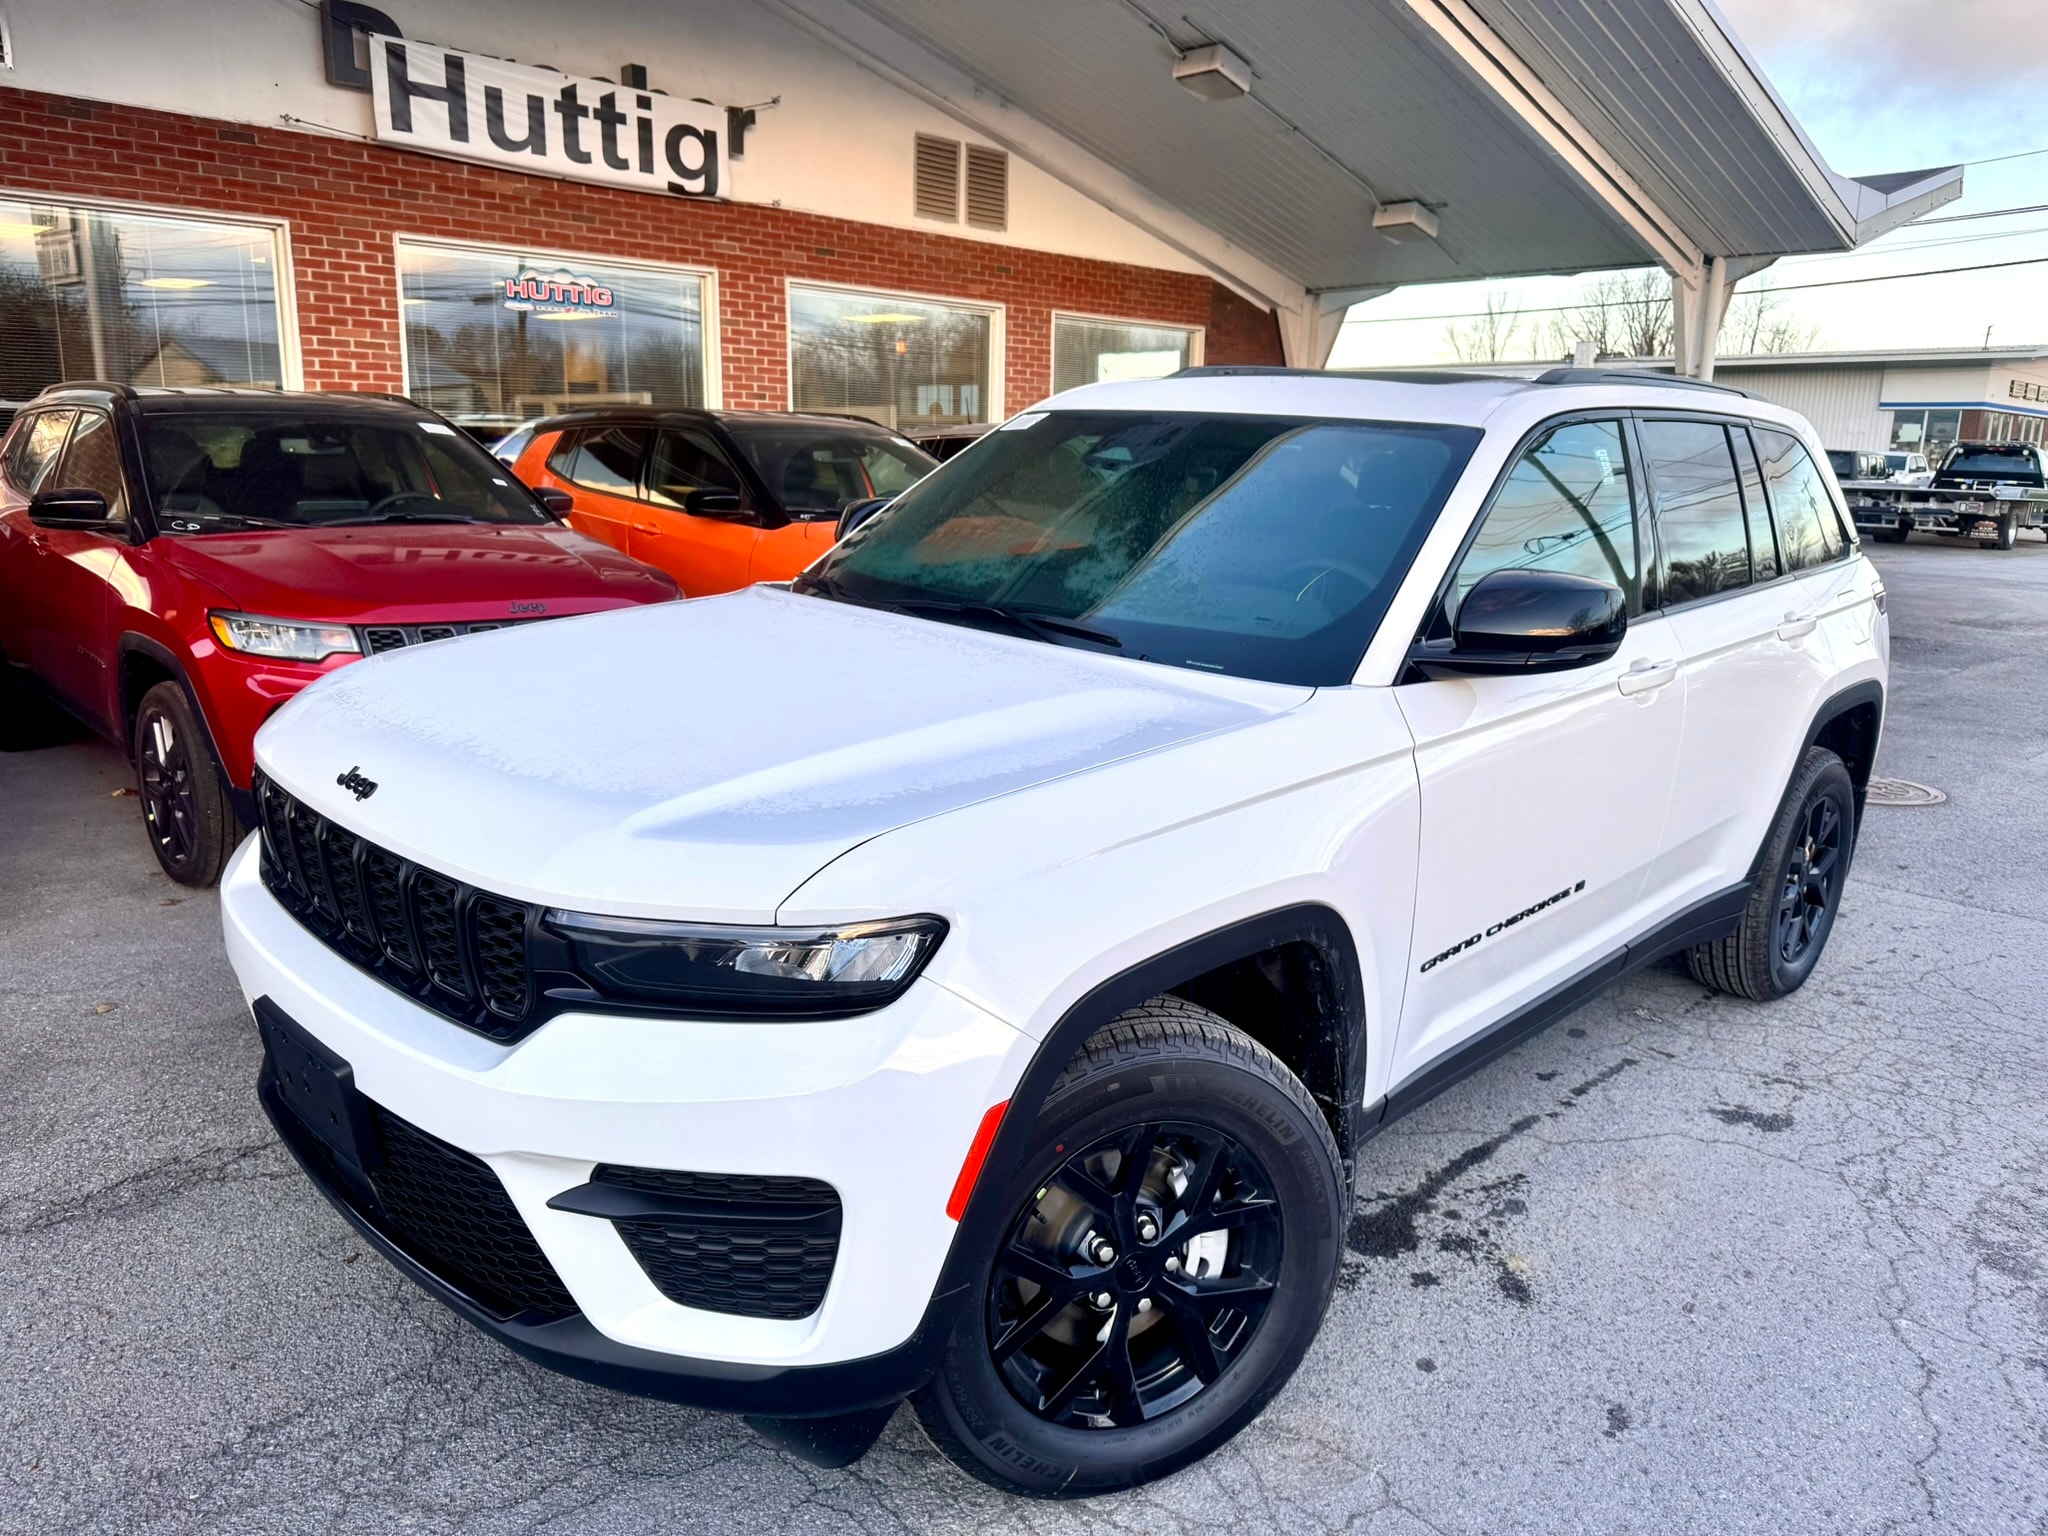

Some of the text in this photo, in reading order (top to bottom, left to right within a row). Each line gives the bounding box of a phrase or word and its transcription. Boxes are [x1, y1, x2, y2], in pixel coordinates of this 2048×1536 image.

[384, 41, 719, 197] Huttig
[506, 279, 612, 306] HUTTIG
[508, 602, 546, 614] Jeep
[336, 765, 379, 802] Jeep
[1420, 887, 1573, 973] GRAND CHEROKEE
[988, 1436, 1062, 1478] CHELIN
